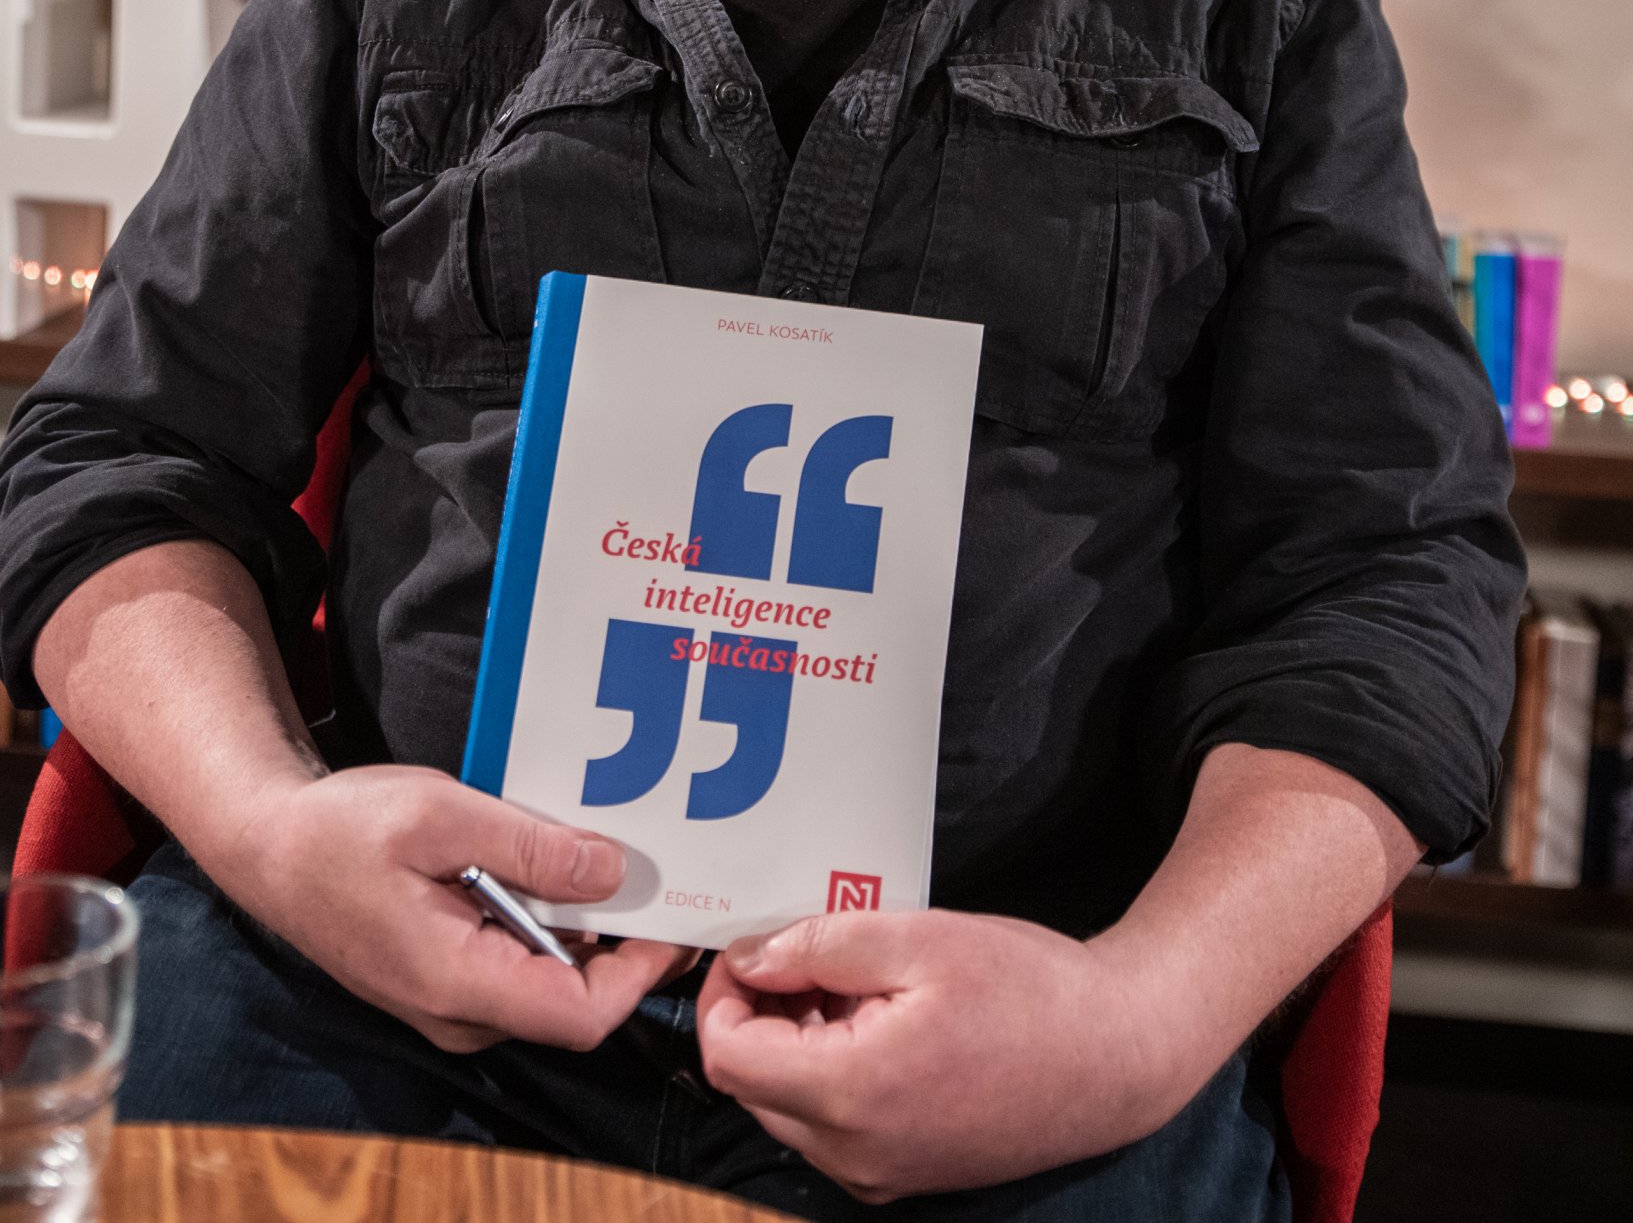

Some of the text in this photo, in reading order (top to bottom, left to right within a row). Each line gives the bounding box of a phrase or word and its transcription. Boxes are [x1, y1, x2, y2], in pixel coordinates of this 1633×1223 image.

[717, 318, 834, 344] PAVEL KOSATÍK
[601, 520, 702, 566] Česká
[643, 578, 831, 629] inteligence
[670, 637, 878, 684] současnosti
[665, 890, 732, 912] EDICE N
